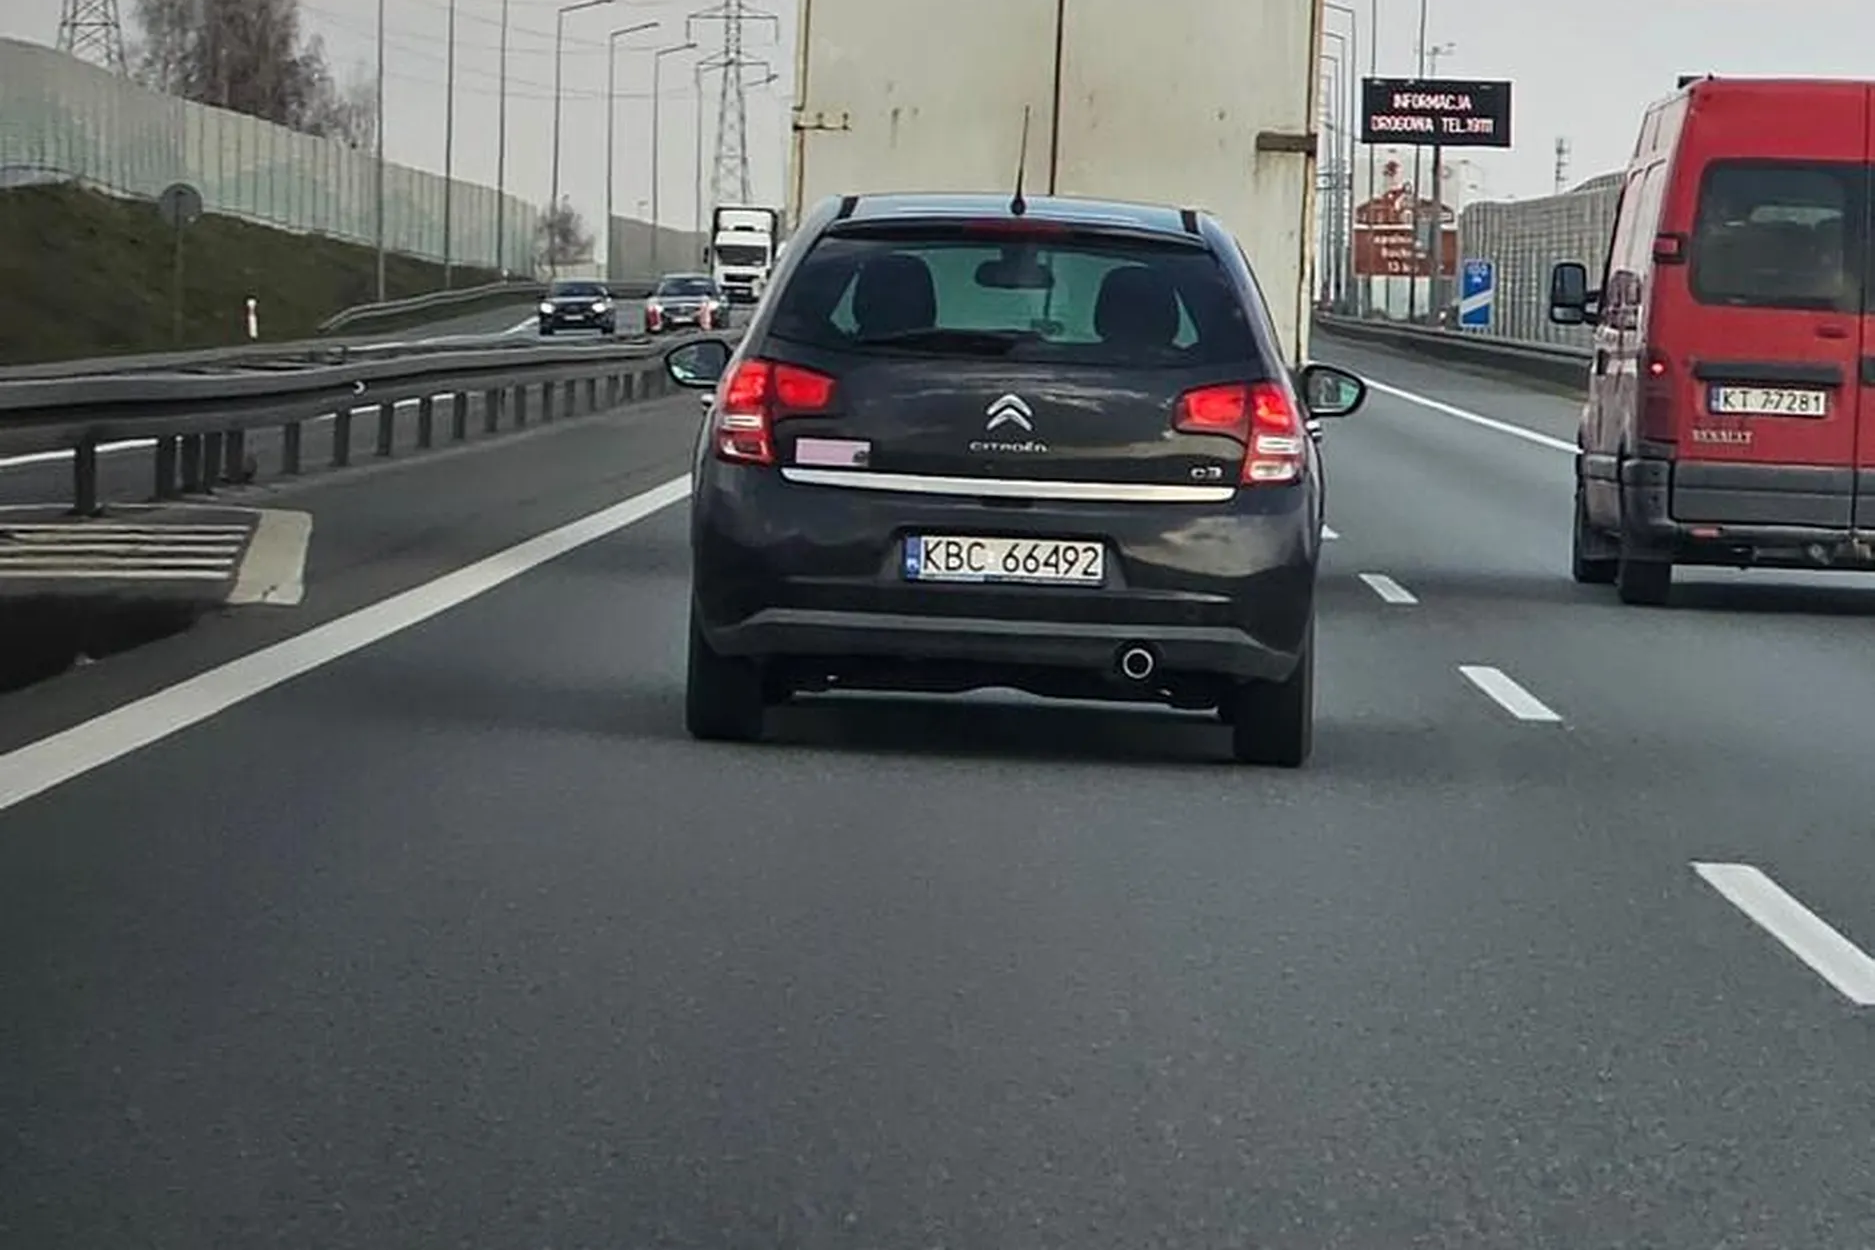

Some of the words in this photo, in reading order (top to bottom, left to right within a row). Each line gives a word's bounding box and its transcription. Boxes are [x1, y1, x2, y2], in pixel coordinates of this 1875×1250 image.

[1392, 93, 1472, 110] INFORMACJA
[1723, 391, 1753, 409] KT
[1761, 391, 1822, 412] 77281
[923, 539, 987, 572] KBC
[1002, 543, 1100, 577] 66492
